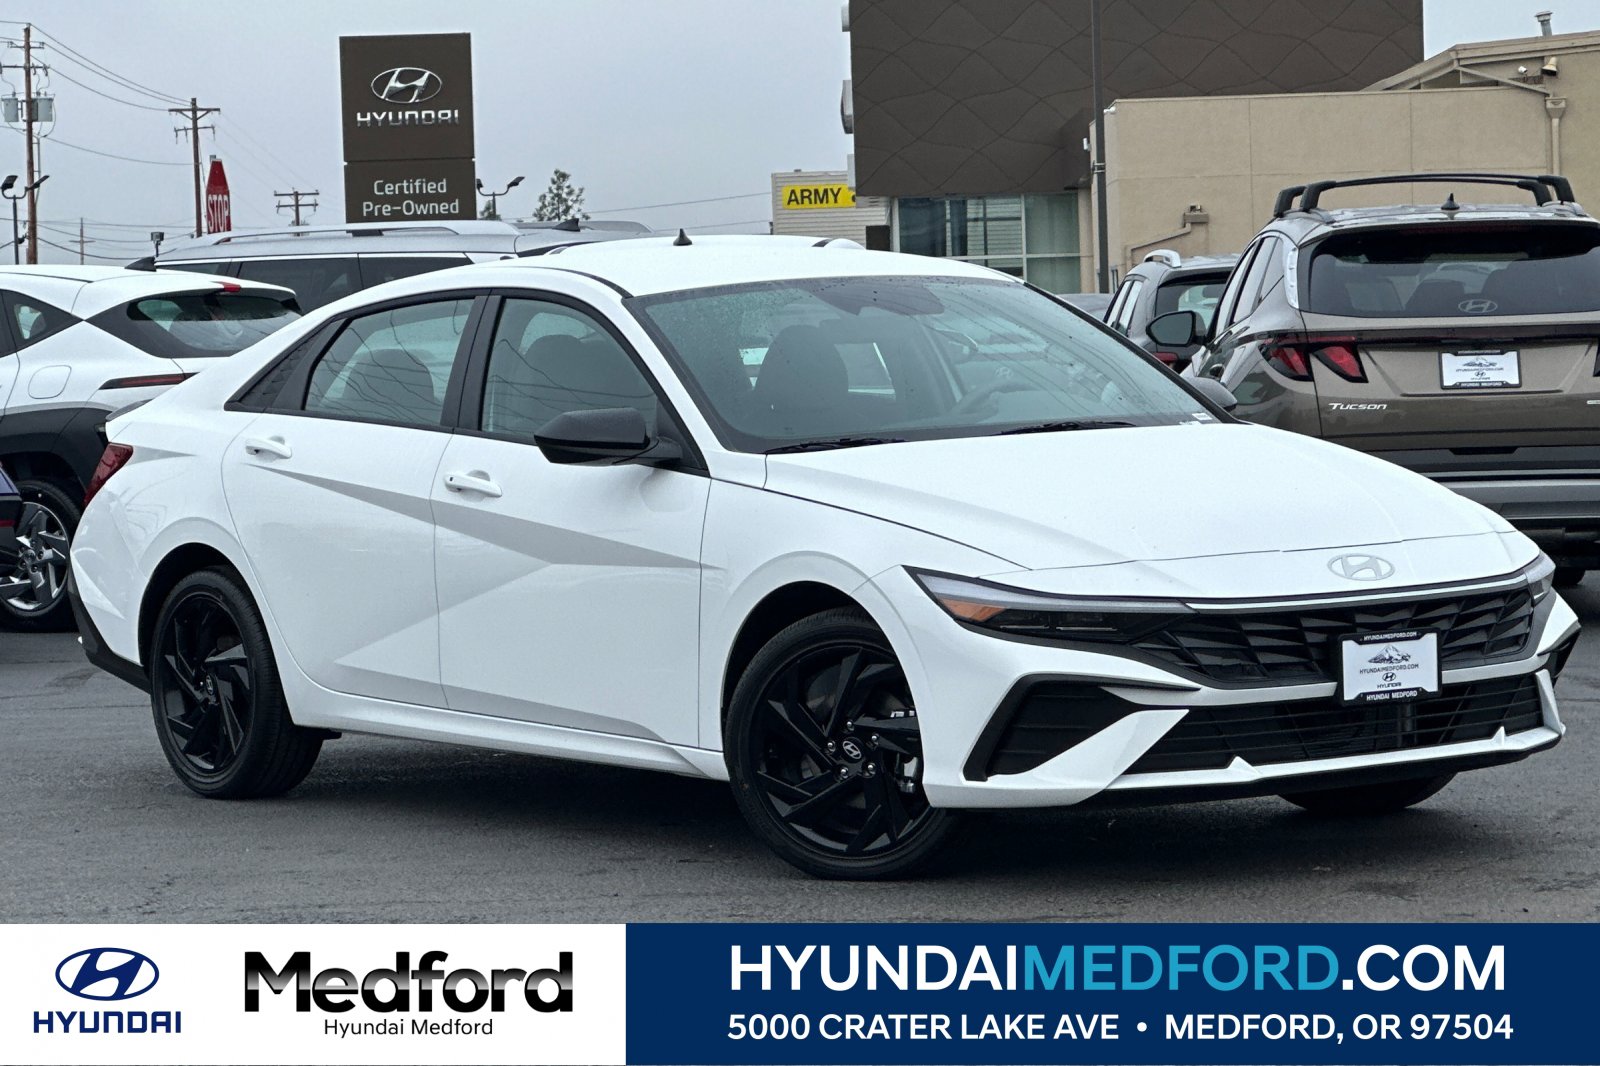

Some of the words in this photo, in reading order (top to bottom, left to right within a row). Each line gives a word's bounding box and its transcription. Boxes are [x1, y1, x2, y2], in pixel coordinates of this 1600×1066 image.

[356, 109, 460, 127] HYUNDAI
[373, 178, 448, 195] Certified
[787, 187, 842, 206] ARMY
[207, 194, 230, 233] STOP
[362, 199, 460, 217] Pre-Owned
[1363, 631, 1417, 641] HYUNDAIMEDFORD.COM
[1360, 663, 1419, 674] HYUNDAIMEDFORD.COM
[1366, 693, 1390, 701] HYUNDAI
[1391, 690, 1418, 699] MEDFORD
